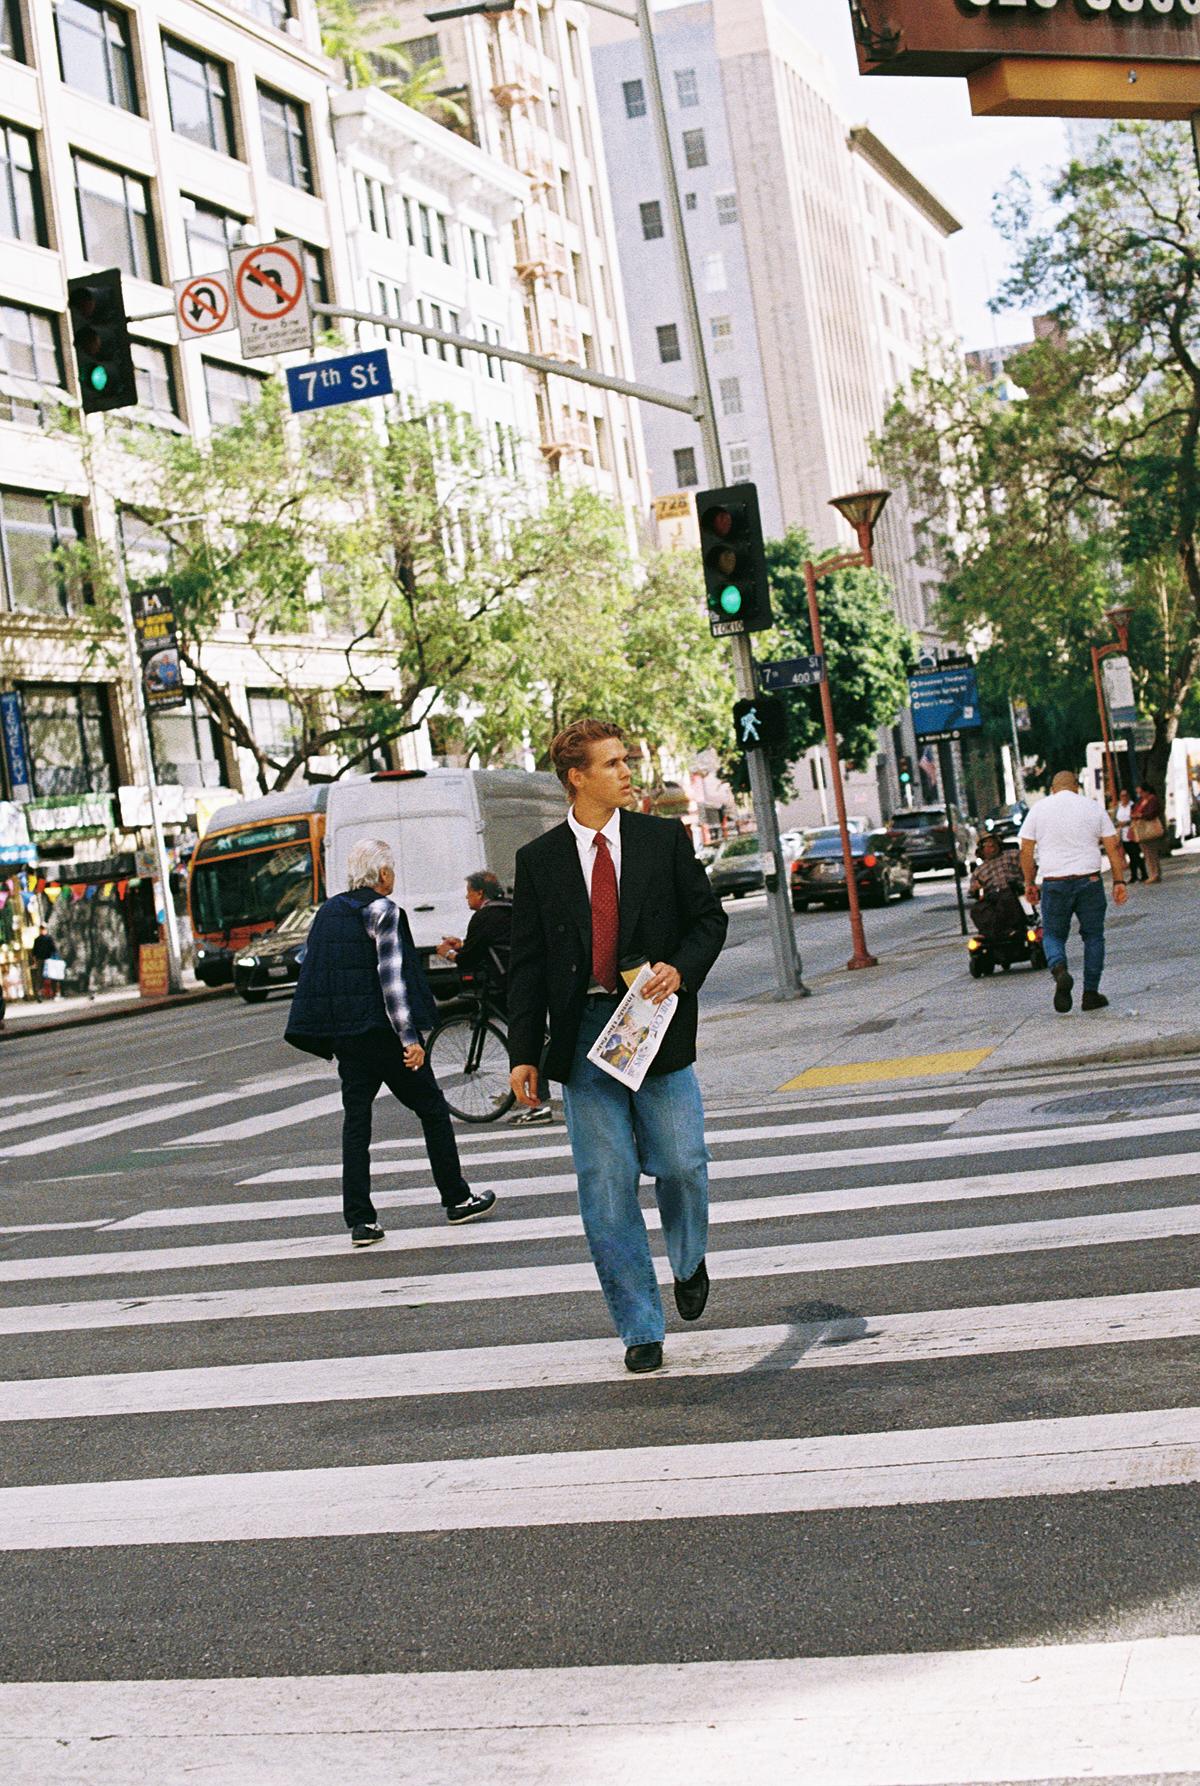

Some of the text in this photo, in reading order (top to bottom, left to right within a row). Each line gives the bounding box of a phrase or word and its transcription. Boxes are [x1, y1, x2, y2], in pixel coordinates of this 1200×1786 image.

[298, 362, 380, 402] 7th St
[808, 658, 819, 668] St
[762, 668, 821, 684] 7th 400 W
